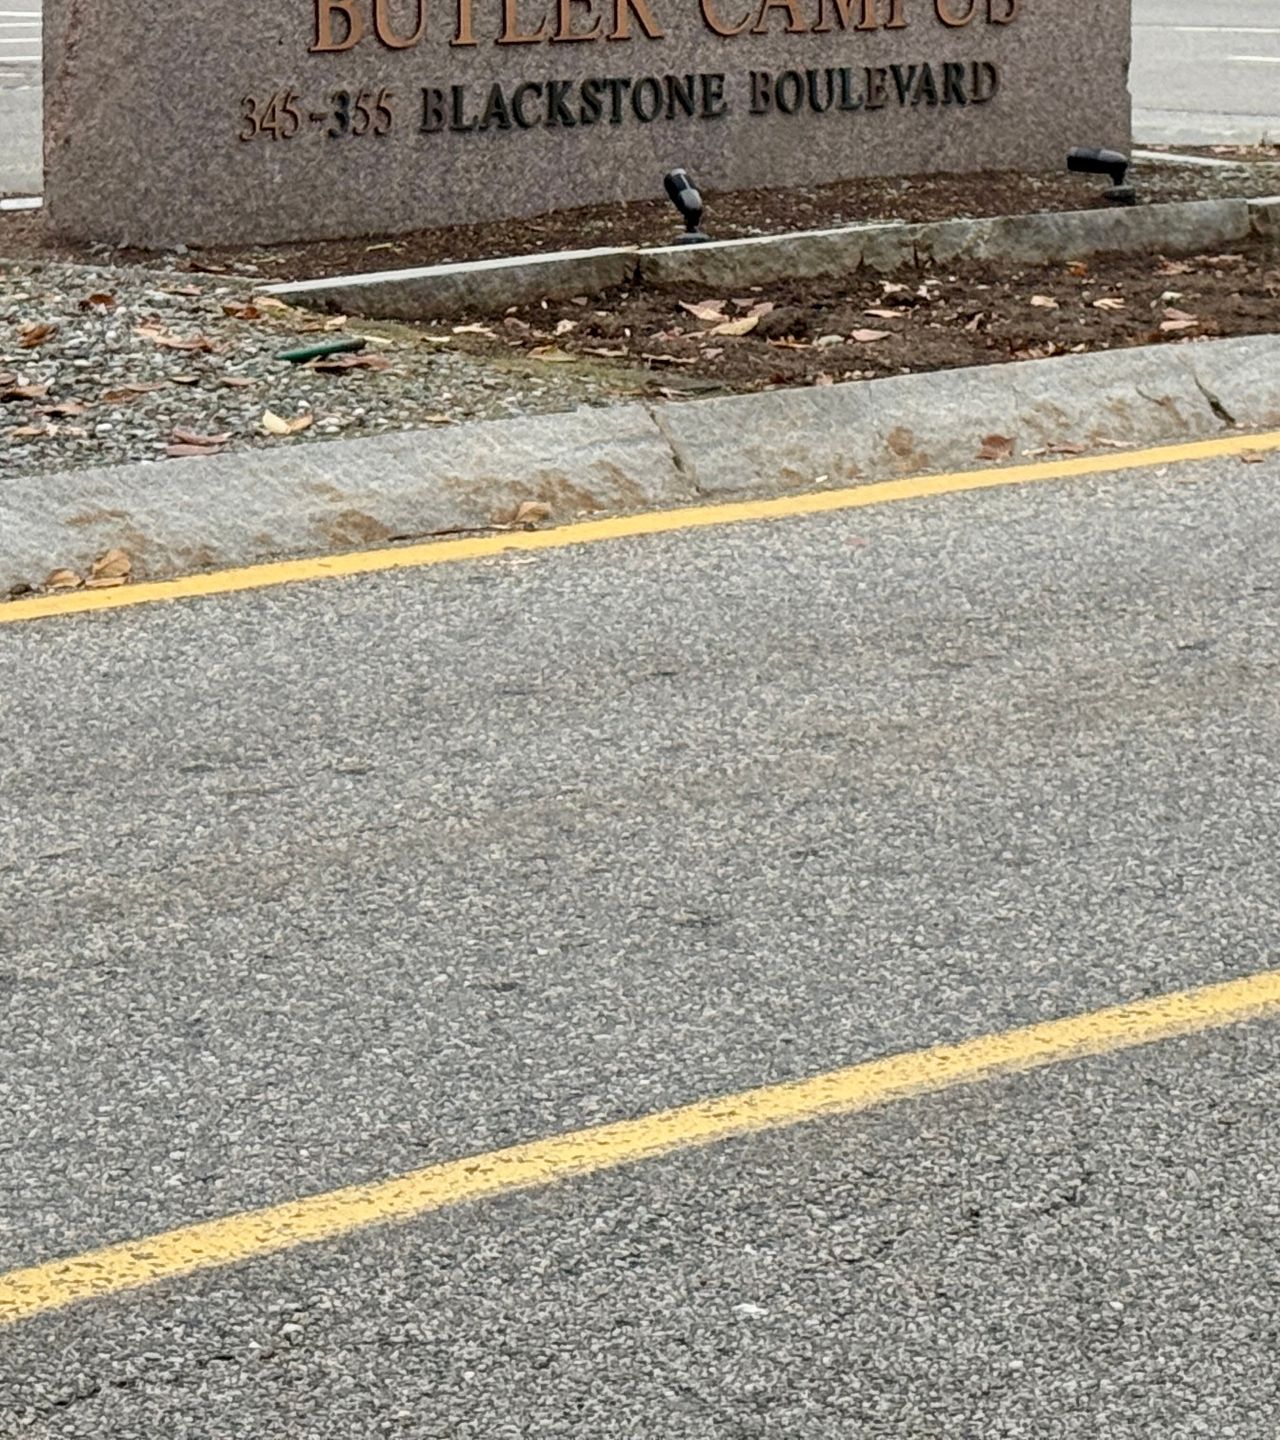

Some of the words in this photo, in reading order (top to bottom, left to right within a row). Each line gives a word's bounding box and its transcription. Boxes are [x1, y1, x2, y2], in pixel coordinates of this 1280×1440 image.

[239, 86, 394, 142] 345-355
[420, 72, 728, 133] BLACKSTONE
[748, 61, 1000, 116] BOULEVARD
